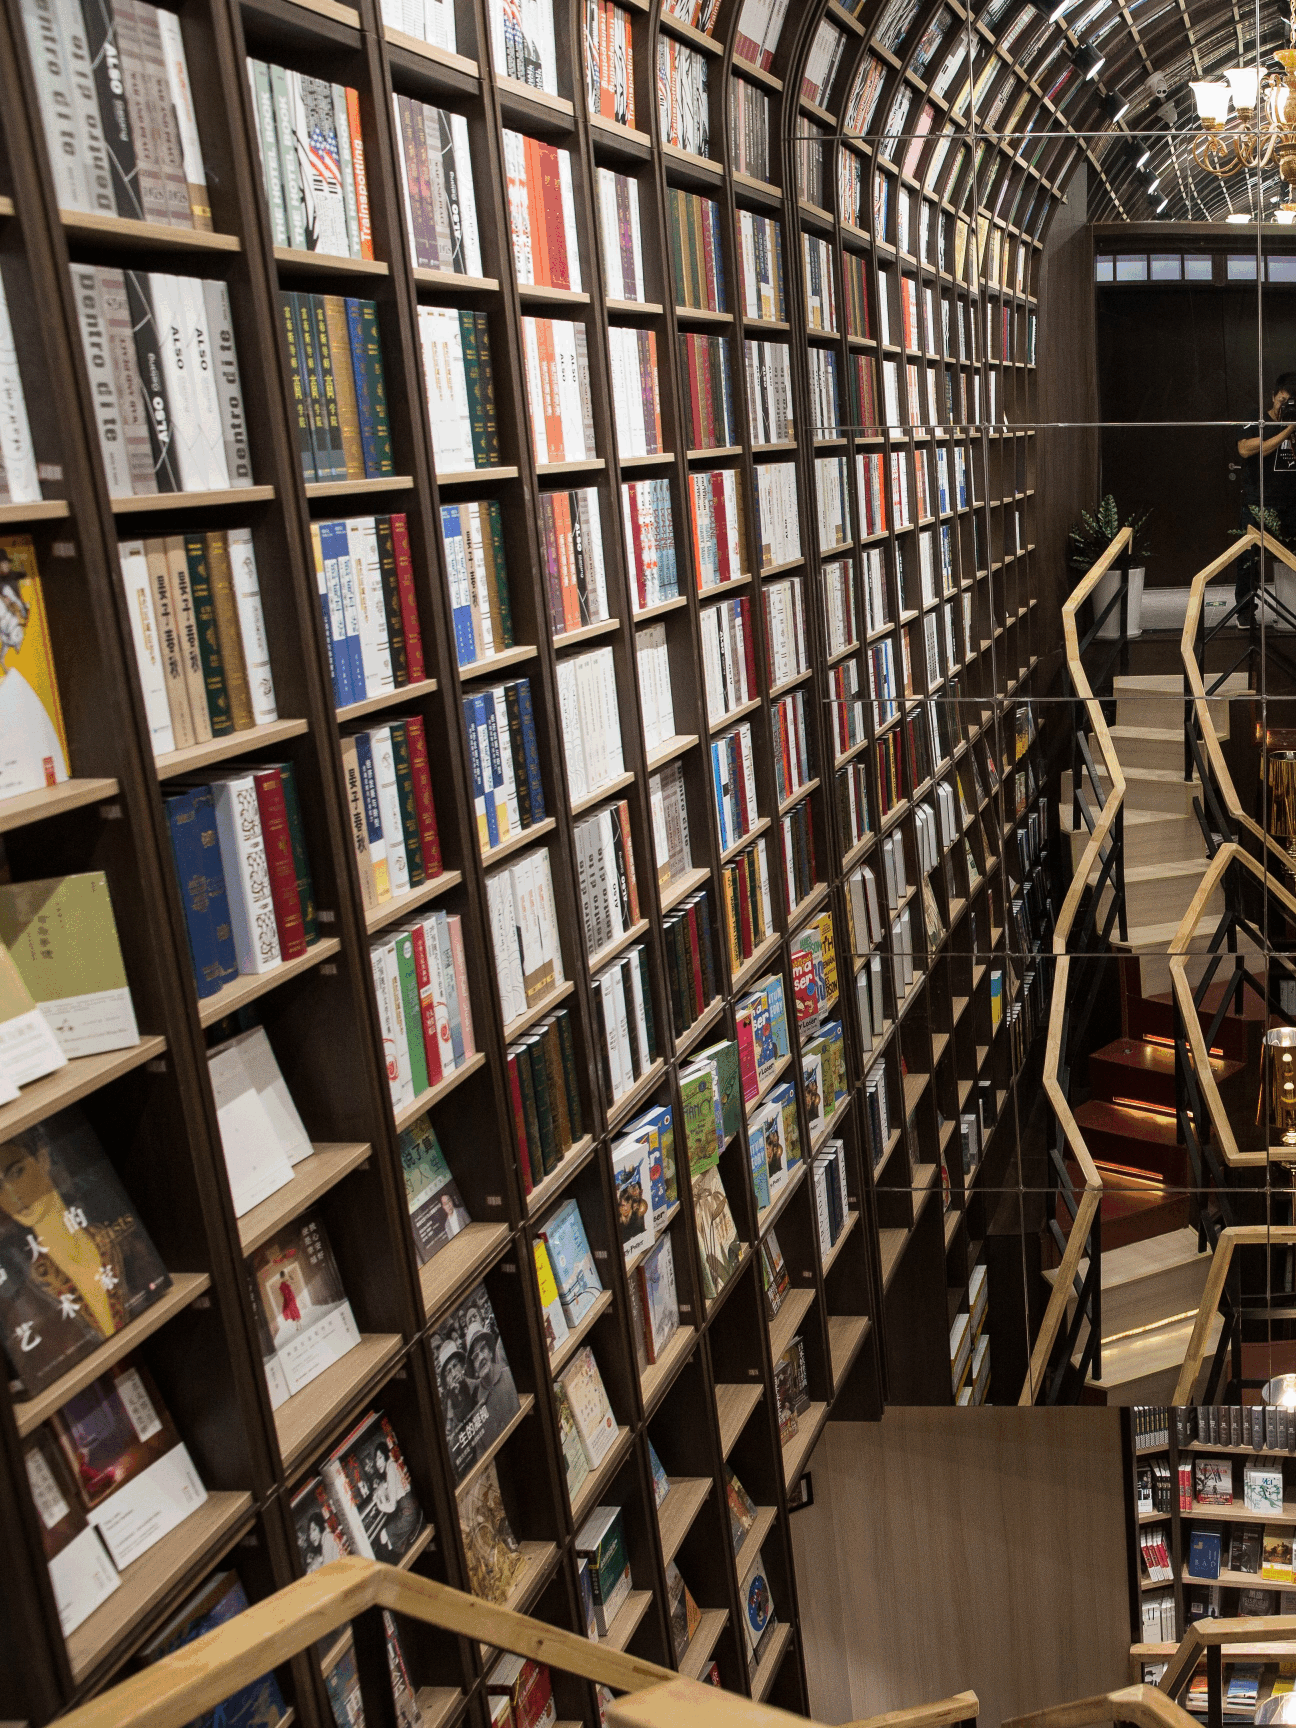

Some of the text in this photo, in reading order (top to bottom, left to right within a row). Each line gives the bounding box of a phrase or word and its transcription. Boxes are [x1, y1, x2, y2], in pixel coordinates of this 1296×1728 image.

[104, 43, 123, 95] ALSO
[627, 48, 635, 120] Trainspotting
[72, 36, 113, 211] Dentro di te
[337, 112, 350, 160] BOOK
[261, 92, 286, 246] THE HOTEL BOOK
[278, 96, 304, 245] THE HOTEL BOOK
[343, 164, 355, 214] HOTEL
[354, 139, 372, 241] Trainspotting
[452, 203, 462, 239] ALSO
[79, 274, 117, 442] Dentro di te
[170, 326, 184, 370] ALSO
[195, 328, 208, 371] ALSO
[152, 397, 169, 442] ALSO
[220, 330, 249, 477] Dentro di te
